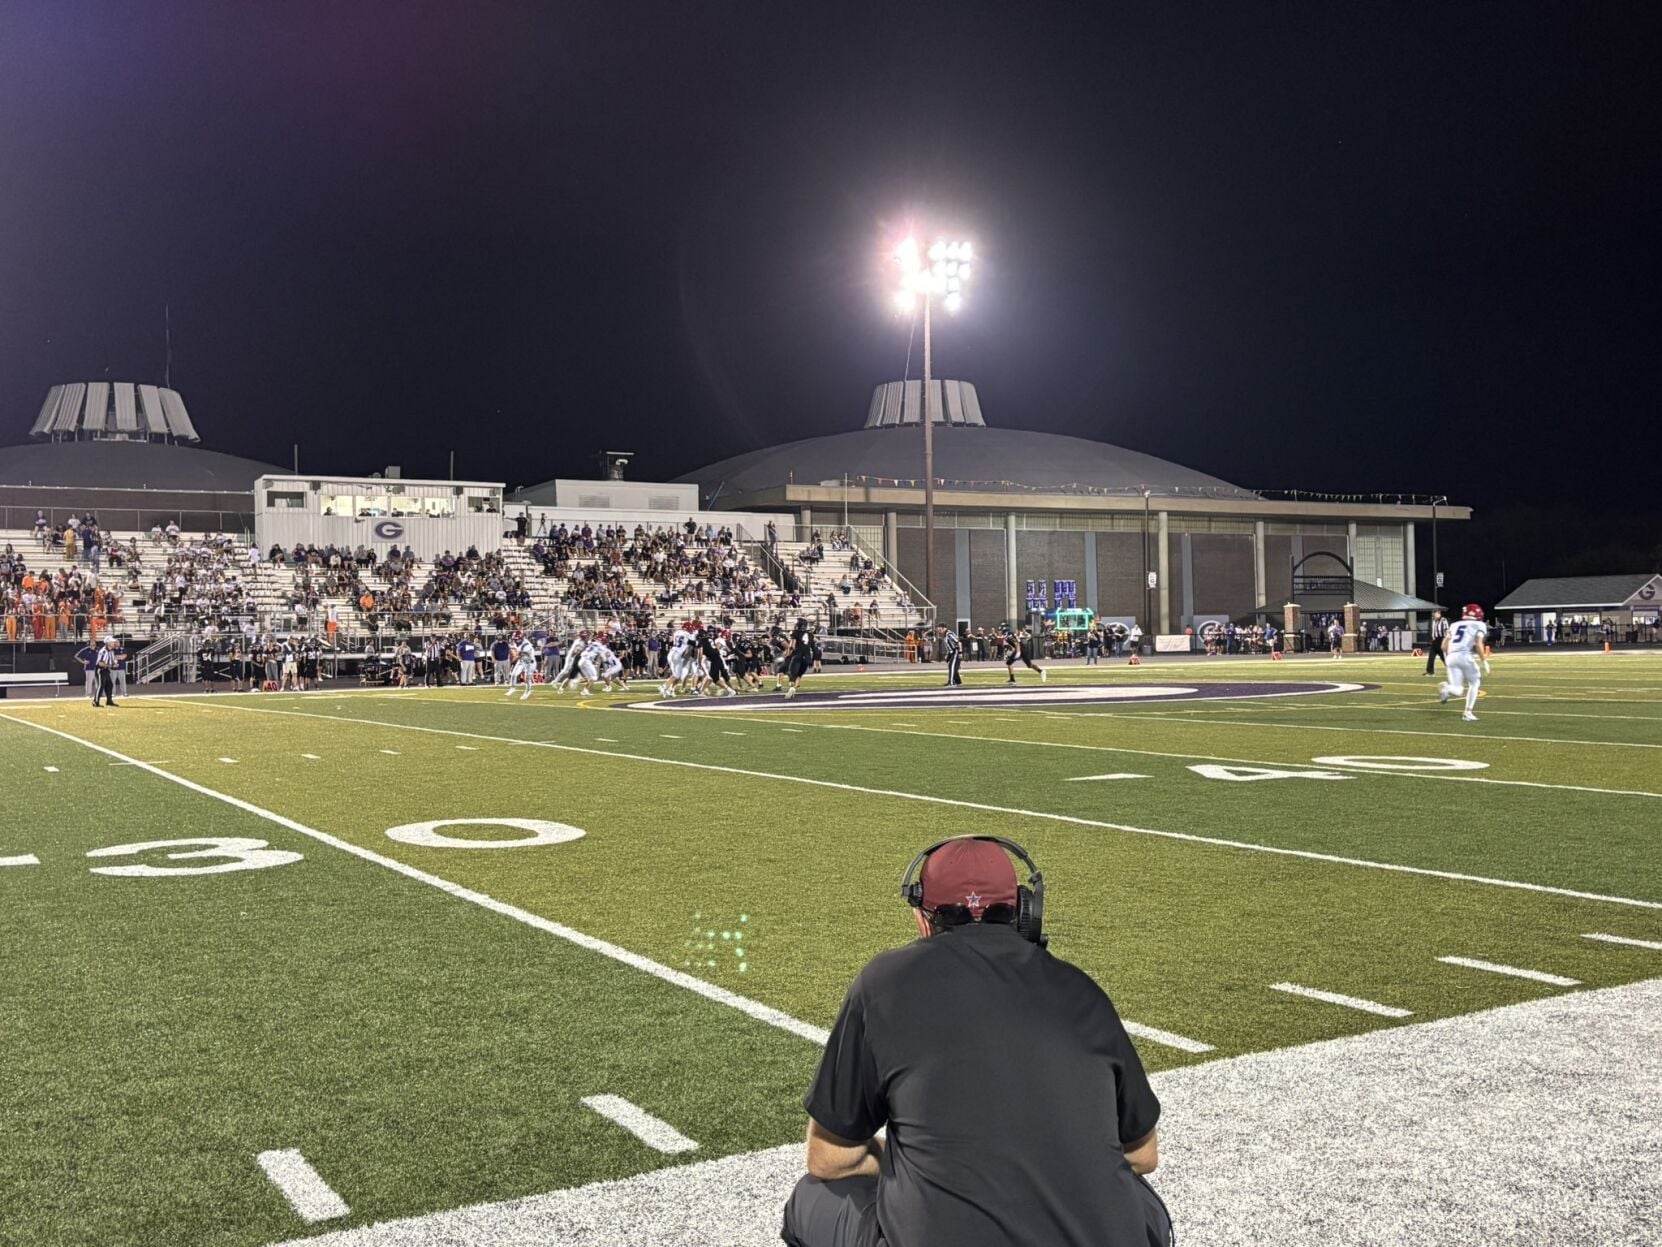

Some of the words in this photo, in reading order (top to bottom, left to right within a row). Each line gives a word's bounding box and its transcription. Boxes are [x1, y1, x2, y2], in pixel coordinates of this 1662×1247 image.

[375, 521, 404, 539] G
[1638, 584, 1656, 601] G
[802, 632, 810, 645] 4
[1452, 624, 1467, 643] 5
[202, 653, 212, 661] 54
[533, 674, 545, 683] 50
[266, 681, 278, 691] 40
